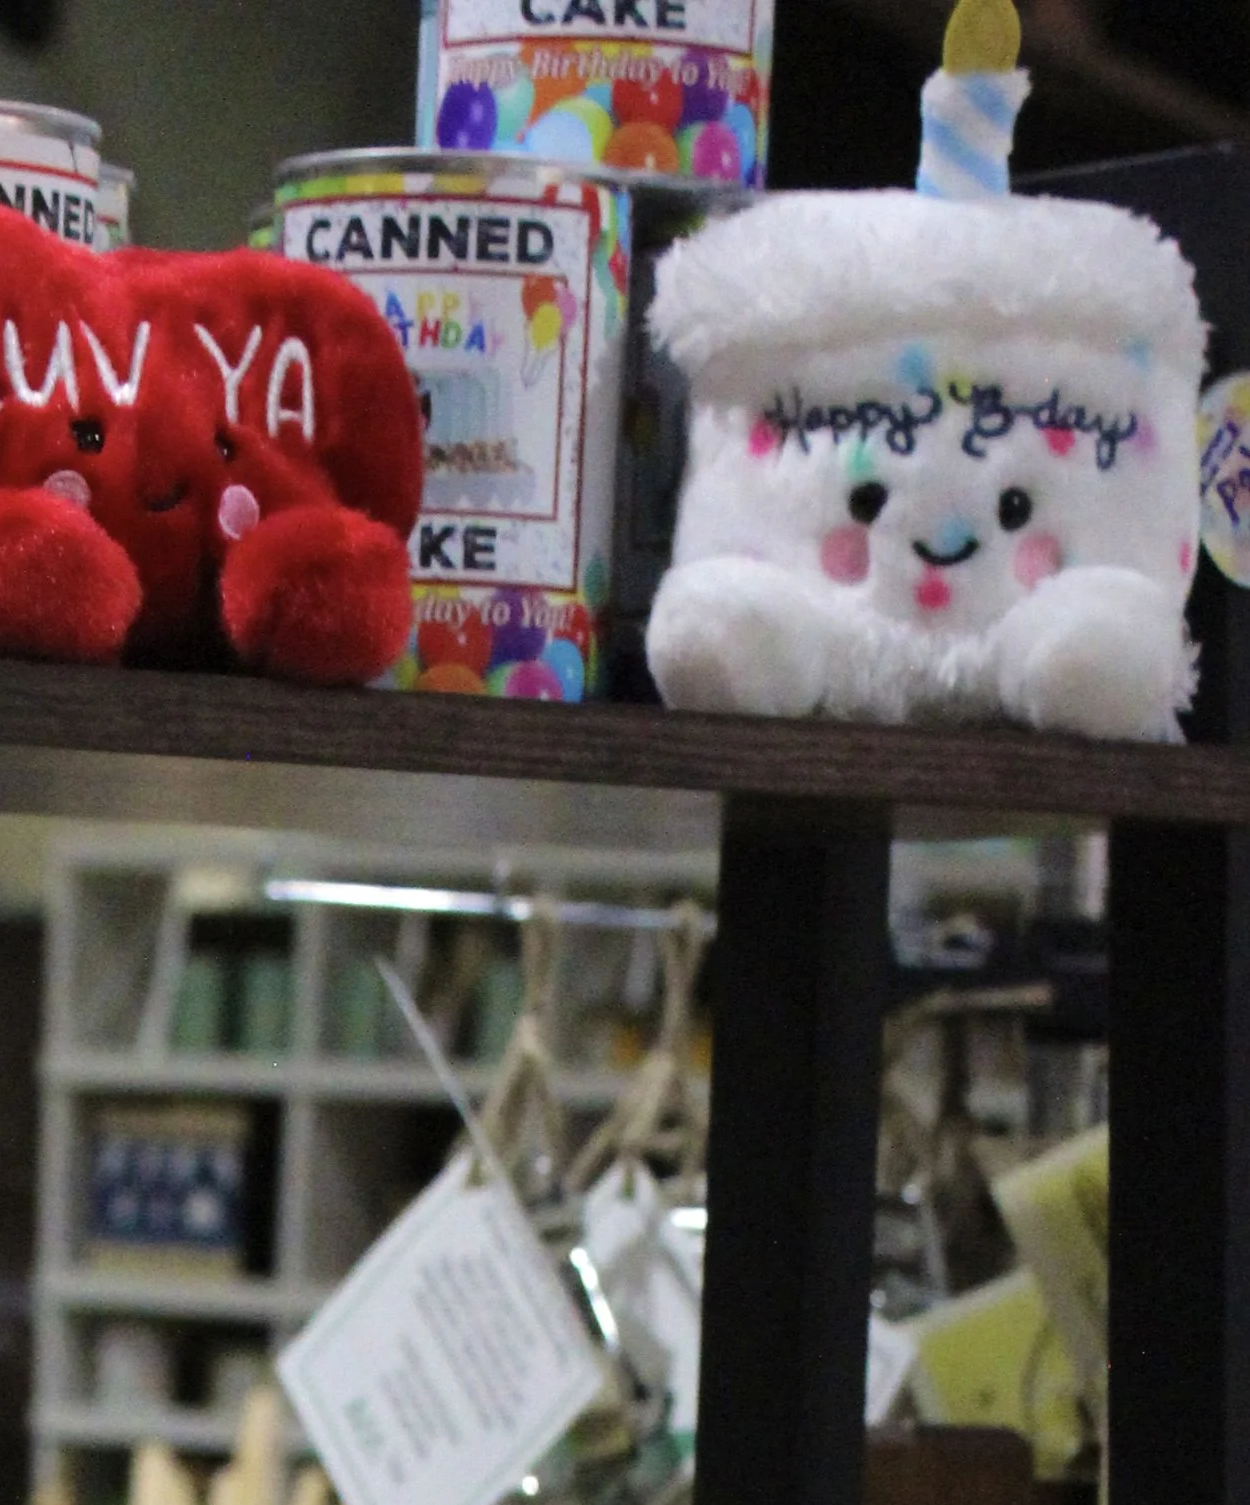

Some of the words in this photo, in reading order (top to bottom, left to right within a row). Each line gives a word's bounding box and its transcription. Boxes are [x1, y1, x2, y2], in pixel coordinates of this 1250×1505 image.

[305, 213, 556, 265] CANNED
[194, 324, 314, 443] YA
[765, 384, 943, 456] Happy
